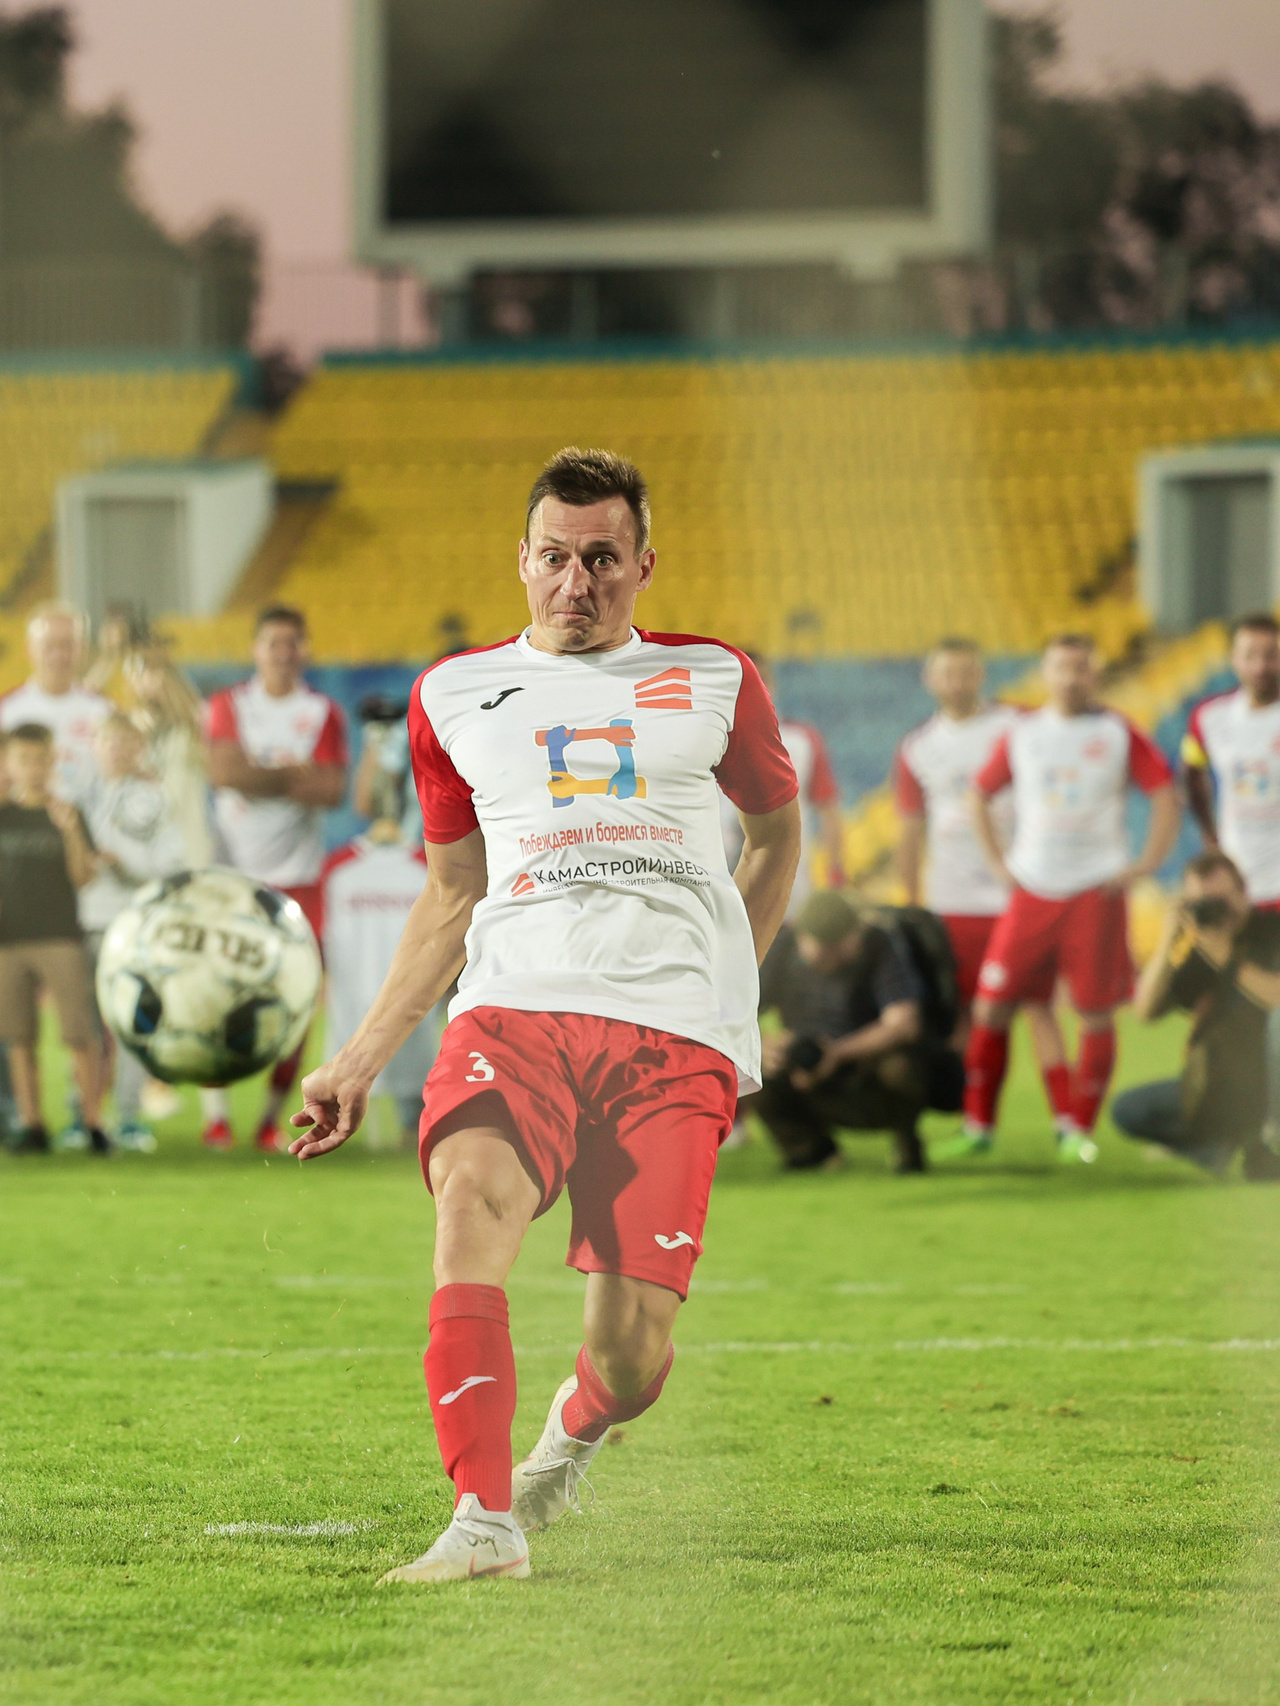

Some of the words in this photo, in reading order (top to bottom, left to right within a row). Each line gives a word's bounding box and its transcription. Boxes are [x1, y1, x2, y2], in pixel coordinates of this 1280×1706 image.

[519, 828, 584, 858] Побеждаем
[586, 827, 594, 843] и
[596, 822, 647, 845] боремся
[649, 825, 683, 846] вместе
[670, 876, 711, 888] КОМПАНИЯ
[465, 1051, 495, 1082] 3
